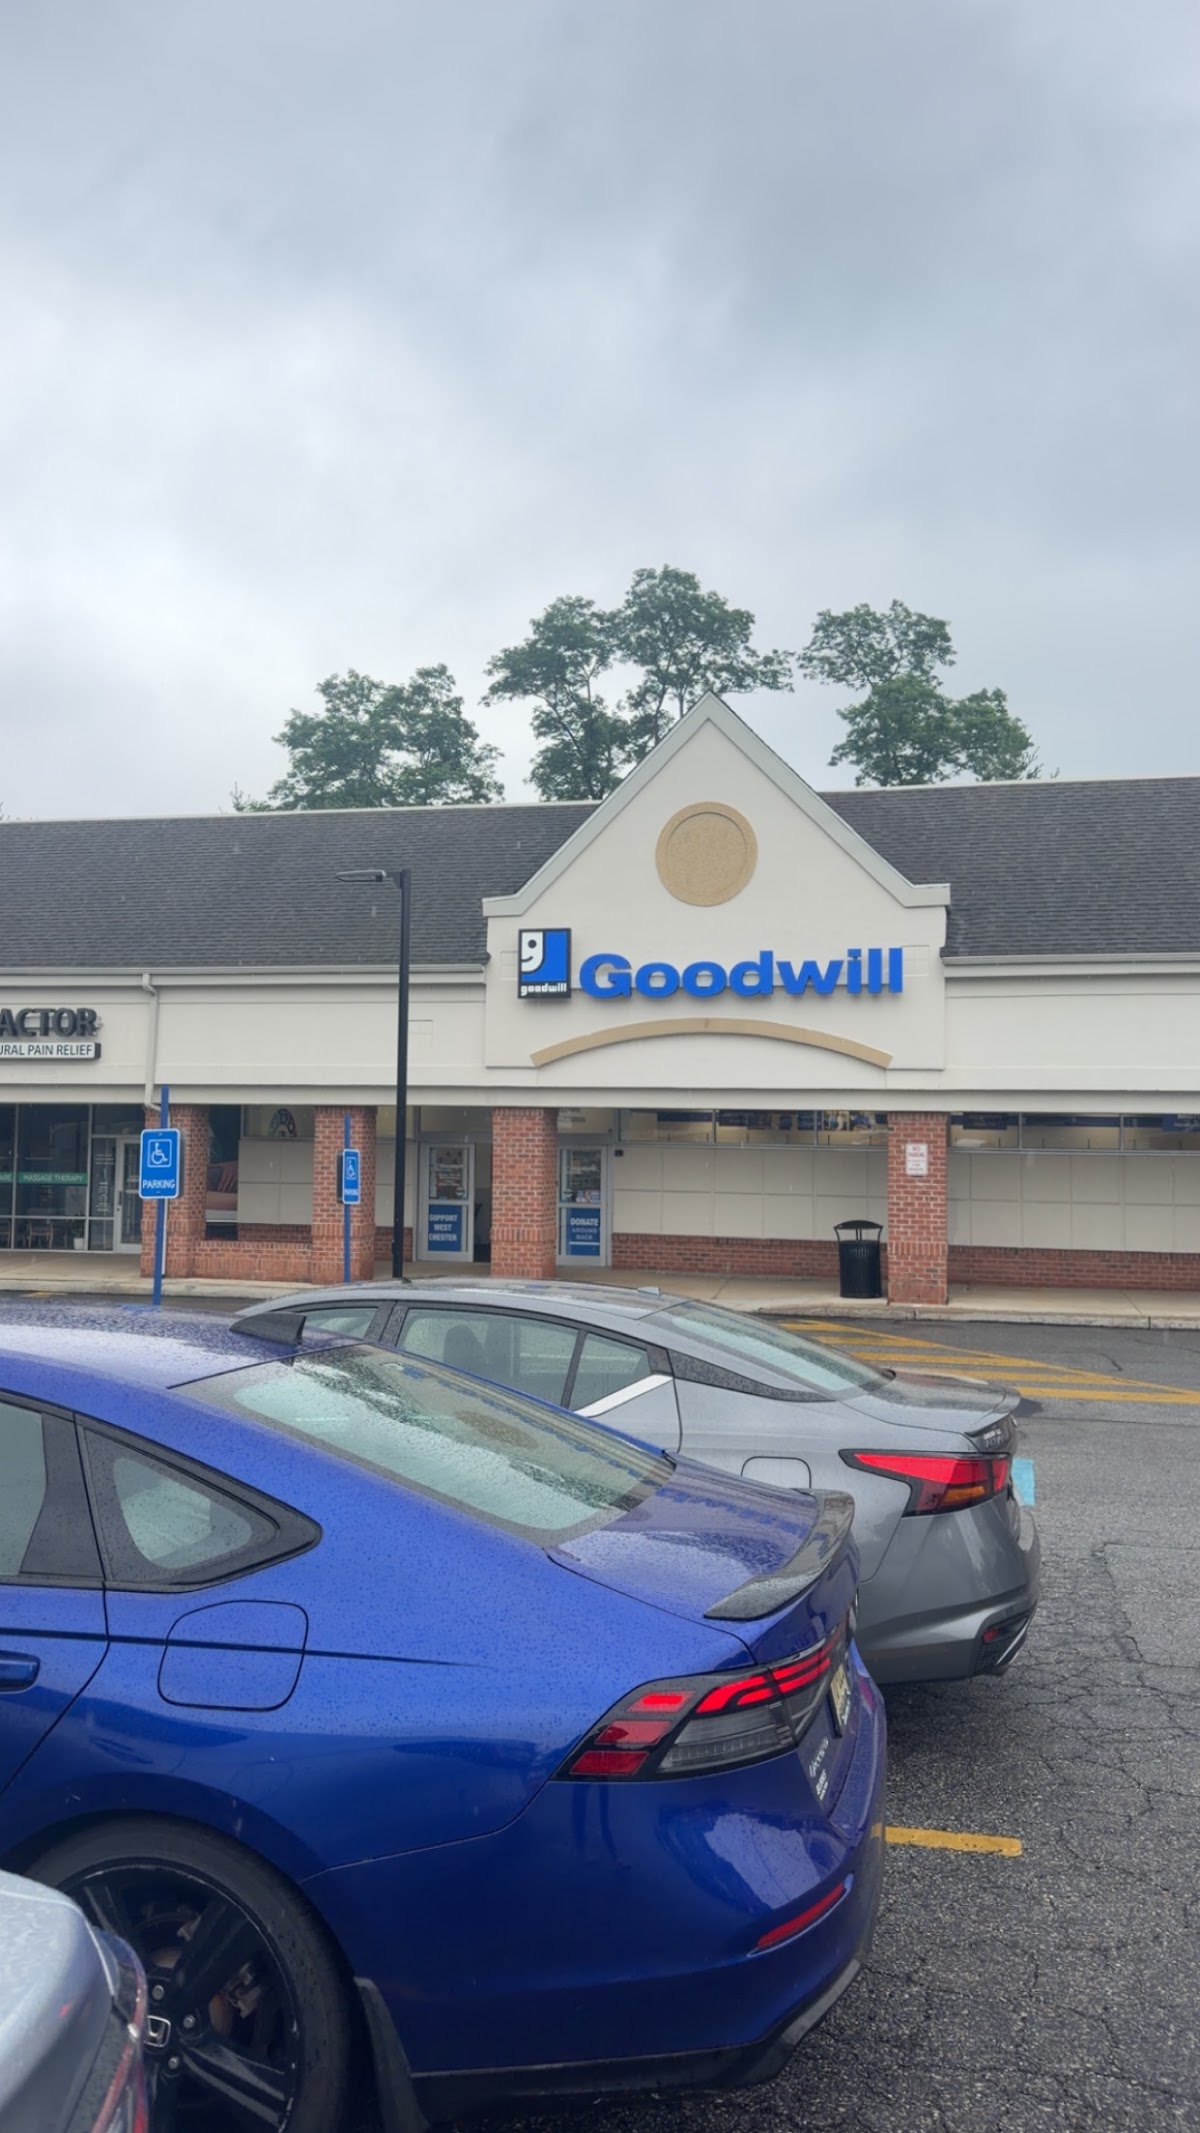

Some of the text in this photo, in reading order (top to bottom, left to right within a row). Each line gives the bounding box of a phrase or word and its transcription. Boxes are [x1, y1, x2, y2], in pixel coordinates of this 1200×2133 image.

[579, 947, 903, 998] Goodwill
[520, 982, 567, 996] goodwill
[0, 1007, 98, 1037] ACTOR
[28, 1044, 53, 1056] PAIN
[56, 1044, 92, 1056] RELIEF
[142, 1179, 176, 1189] PARKING
[429, 1214, 458, 1222] SUPPORT
[570, 1217, 600, 1226] DONATE
[433, 1223, 453, 1231] WEST
[428, 1233, 458, 1241] CHESTER
